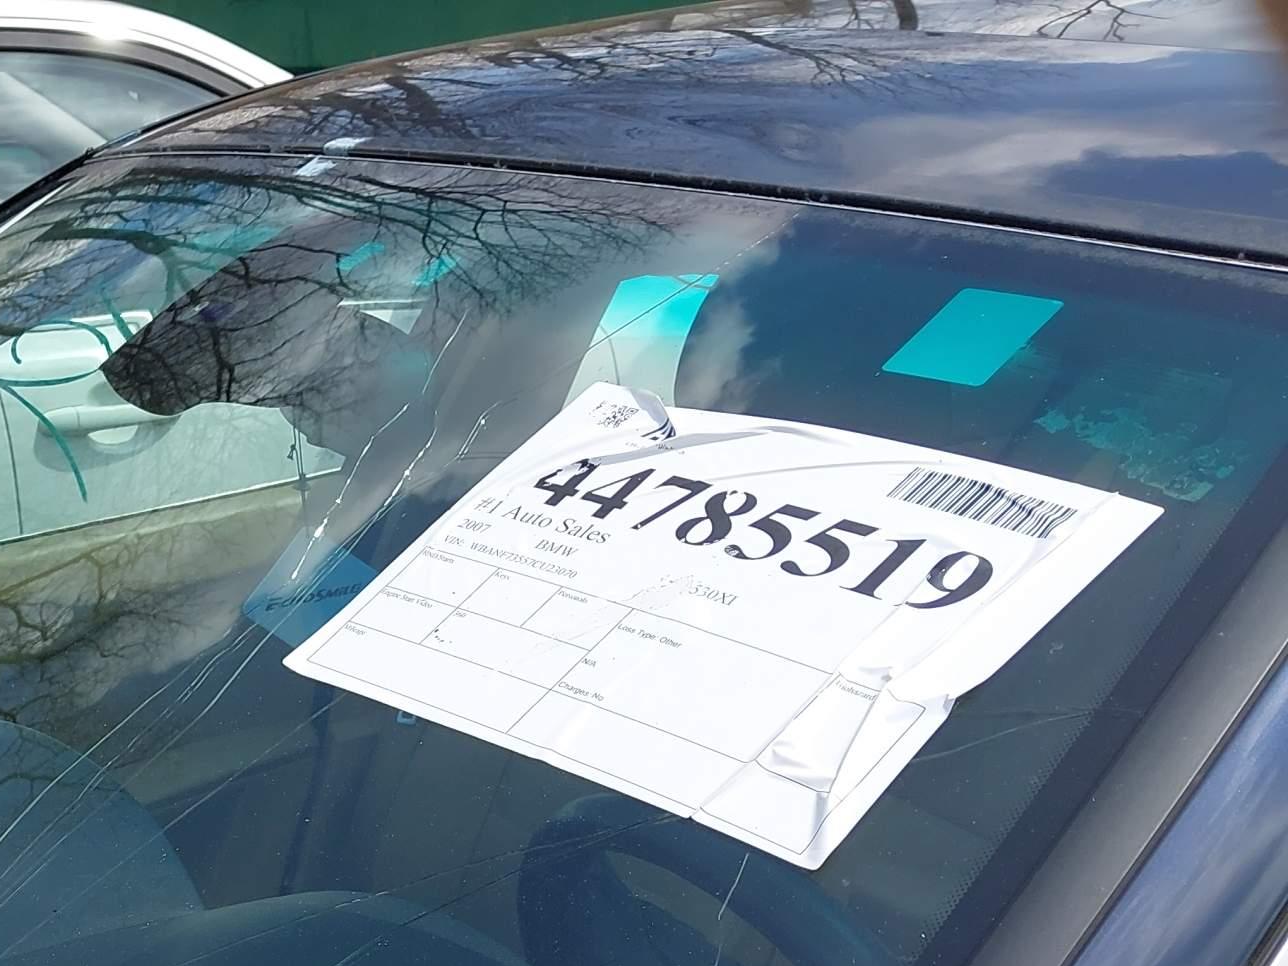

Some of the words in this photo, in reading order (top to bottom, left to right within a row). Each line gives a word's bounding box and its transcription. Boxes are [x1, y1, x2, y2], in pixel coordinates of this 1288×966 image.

[457, 518, 492, 535] 2007
[535, 539, 580, 558] BMW
[473, 497, 503, 515] #1
[501, 505, 553, 529] Auto
[555, 517, 612, 544] Sales
[534, 459, 993, 609] 44785519
[659, 635, 683, 650] Other
